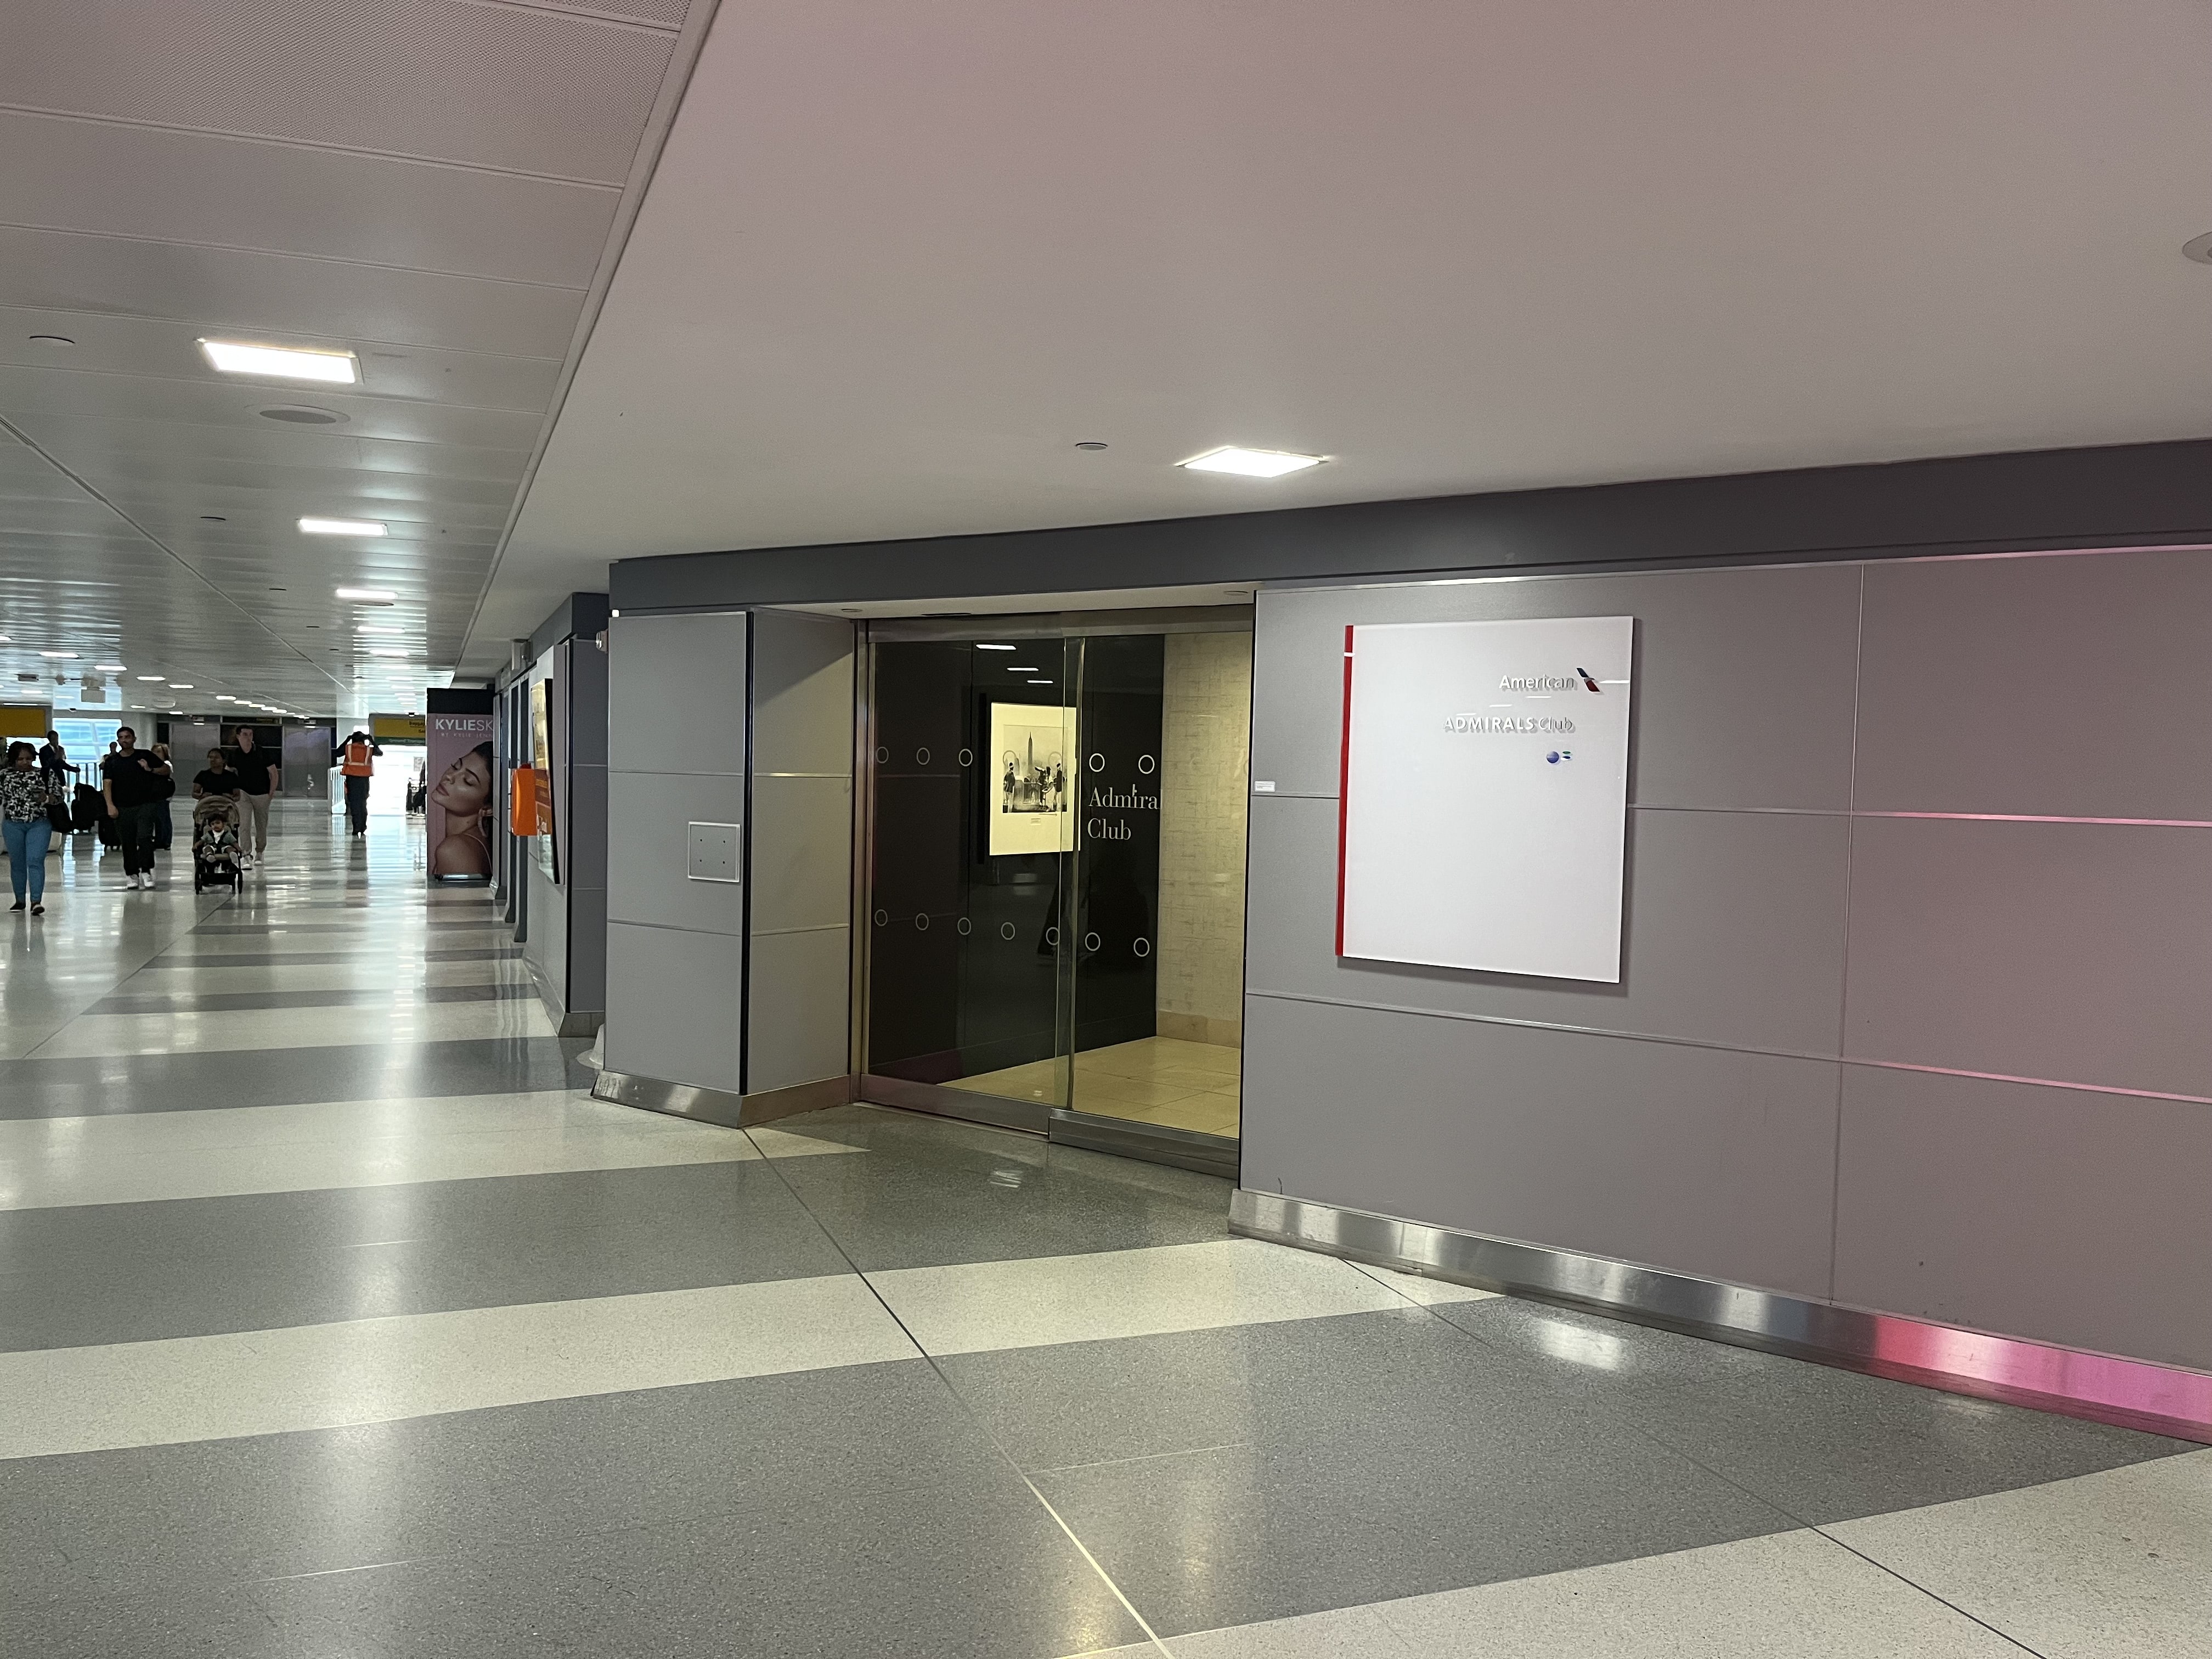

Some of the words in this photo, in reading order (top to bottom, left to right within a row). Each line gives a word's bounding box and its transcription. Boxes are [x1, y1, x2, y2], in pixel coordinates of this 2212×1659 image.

[1498, 674, 1576, 690] American
[1443, 716, 1535, 731] ADMIRALS
[1538, 716, 1574, 731] Club
[1087, 817, 1132, 840] Club
